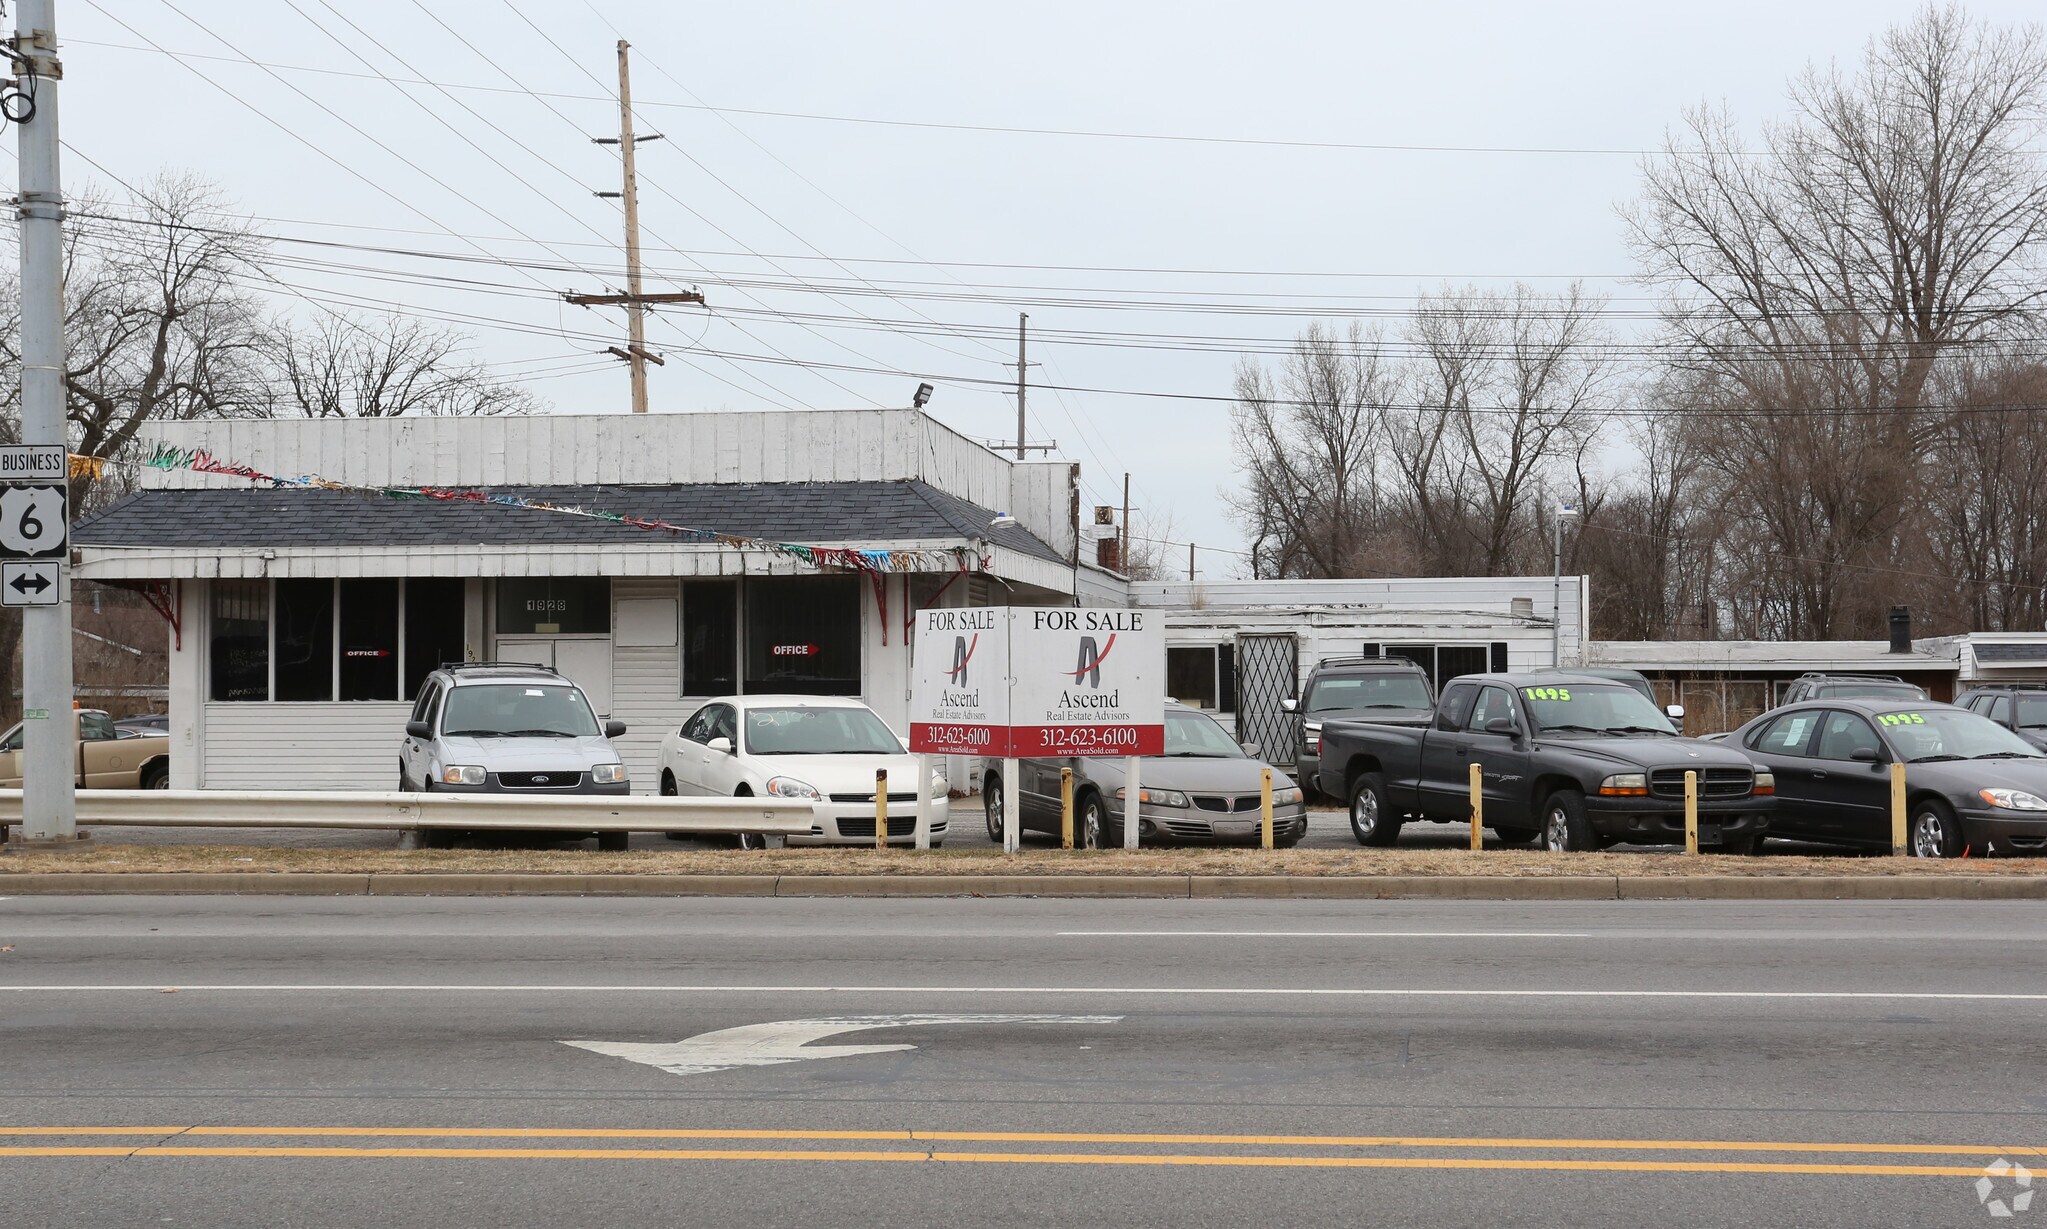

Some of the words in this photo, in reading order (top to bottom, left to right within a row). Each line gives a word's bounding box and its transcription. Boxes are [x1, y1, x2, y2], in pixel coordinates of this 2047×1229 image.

[2, 454, 60, 471] BUSINESS
[19, 503, 43, 540] 6
[526, 600, 566, 611] 1928
[928, 612, 956, 631] FOR
[959, 610, 995, 630] SALE
[1033, 610, 1080, 631] FOR
[1086, 611, 1144, 632] SALE
[773, 645, 808, 655] OFFICE
[940, 688, 979, 708] Ascend
[1058, 688, 1119, 709] Ascend
[1526, 687, 1572, 701] 1495
[932, 708, 945, 719] Real
[945, 709, 961, 720] Estate
[962, 710, 987, 720] Advisors
[1046, 711, 1065, 721] Real
[1067, 711, 1092, 721] Estate
[1094, 710, 1130, 721] Advisors
[1877, 713, 1926, 727] 1995
[927, 726, 991, 745] 312-623-6100
[1040, 727, 1137, 746] 312-623-6100
[938, 746, 979, 754] www.AreaSold.com
[1057, 747, 1119, 755] www.AreaSold.com
